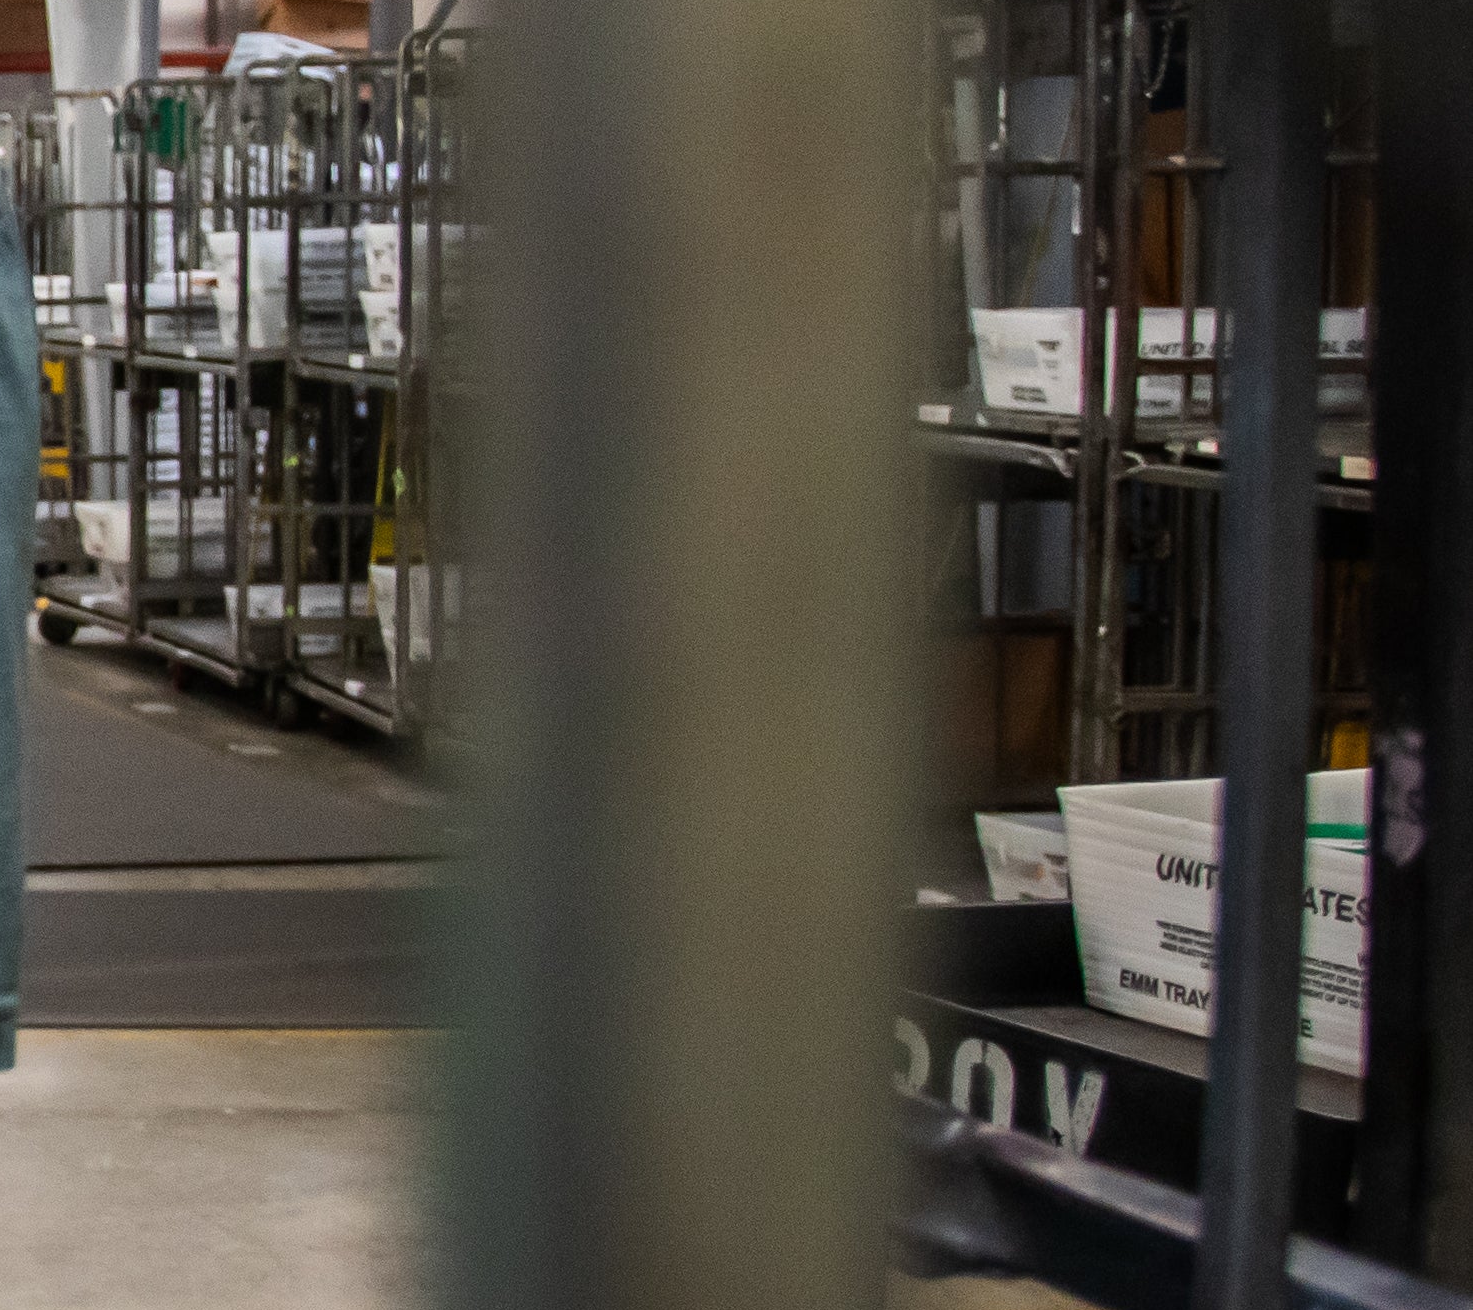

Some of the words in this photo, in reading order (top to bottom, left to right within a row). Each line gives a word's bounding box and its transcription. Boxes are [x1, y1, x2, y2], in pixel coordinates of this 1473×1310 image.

[1155, 853, 1219, 890] UNIT
[1302, 886, 1370, 928] ATES
[1119, 968, 1159, 998] EMM
[1163, 980, 1211, 1010] TRAY
